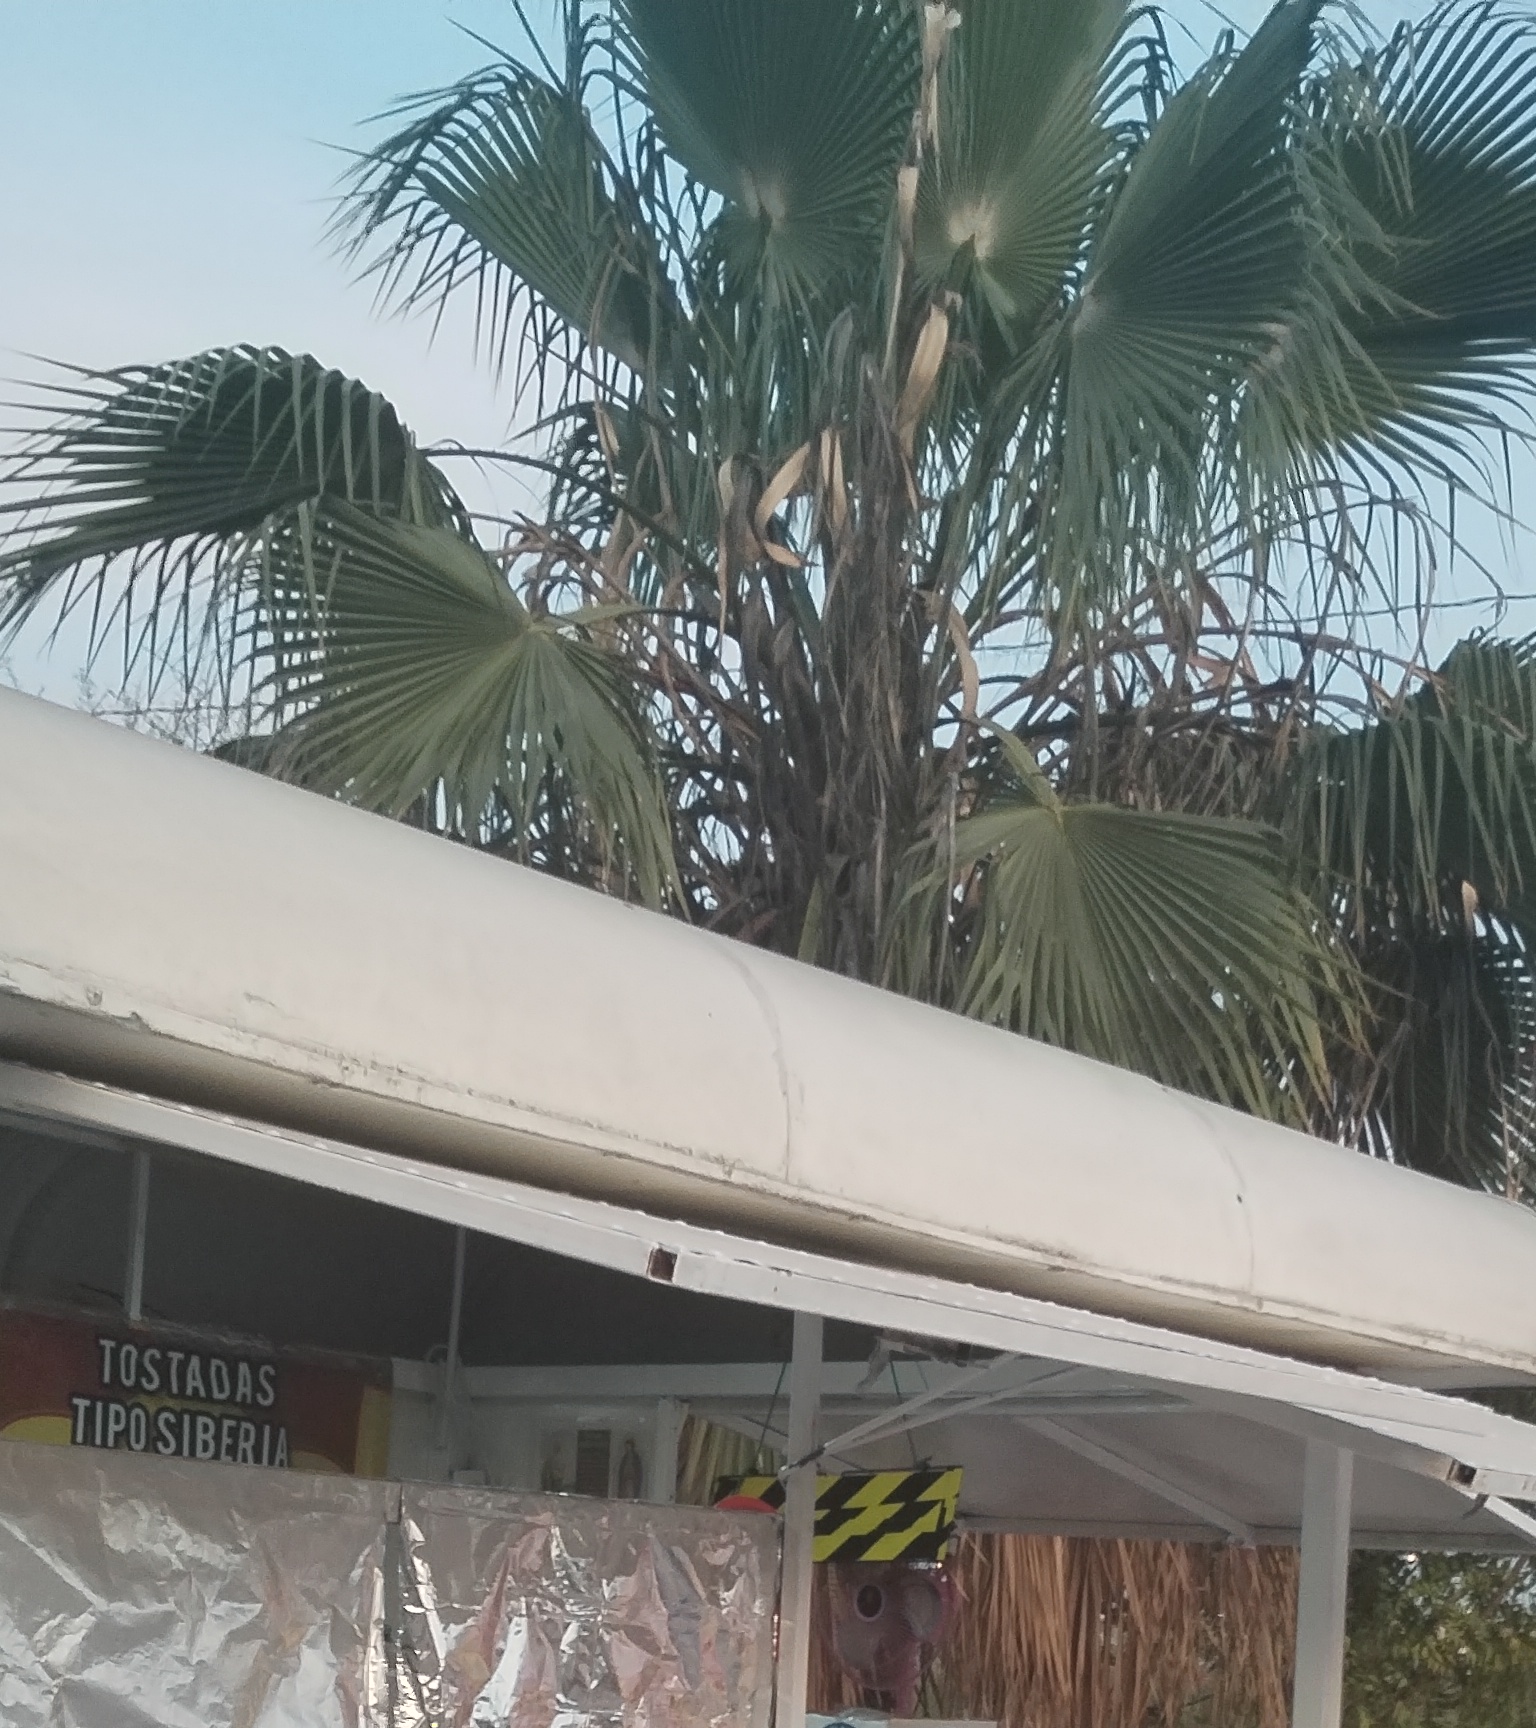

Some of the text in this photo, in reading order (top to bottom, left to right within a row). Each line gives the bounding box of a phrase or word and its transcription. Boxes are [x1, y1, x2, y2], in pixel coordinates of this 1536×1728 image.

[98, 1338, 276, 1408] TOSTADAS
[71, 1397, 289, 1468] TIPO SIBERIA
